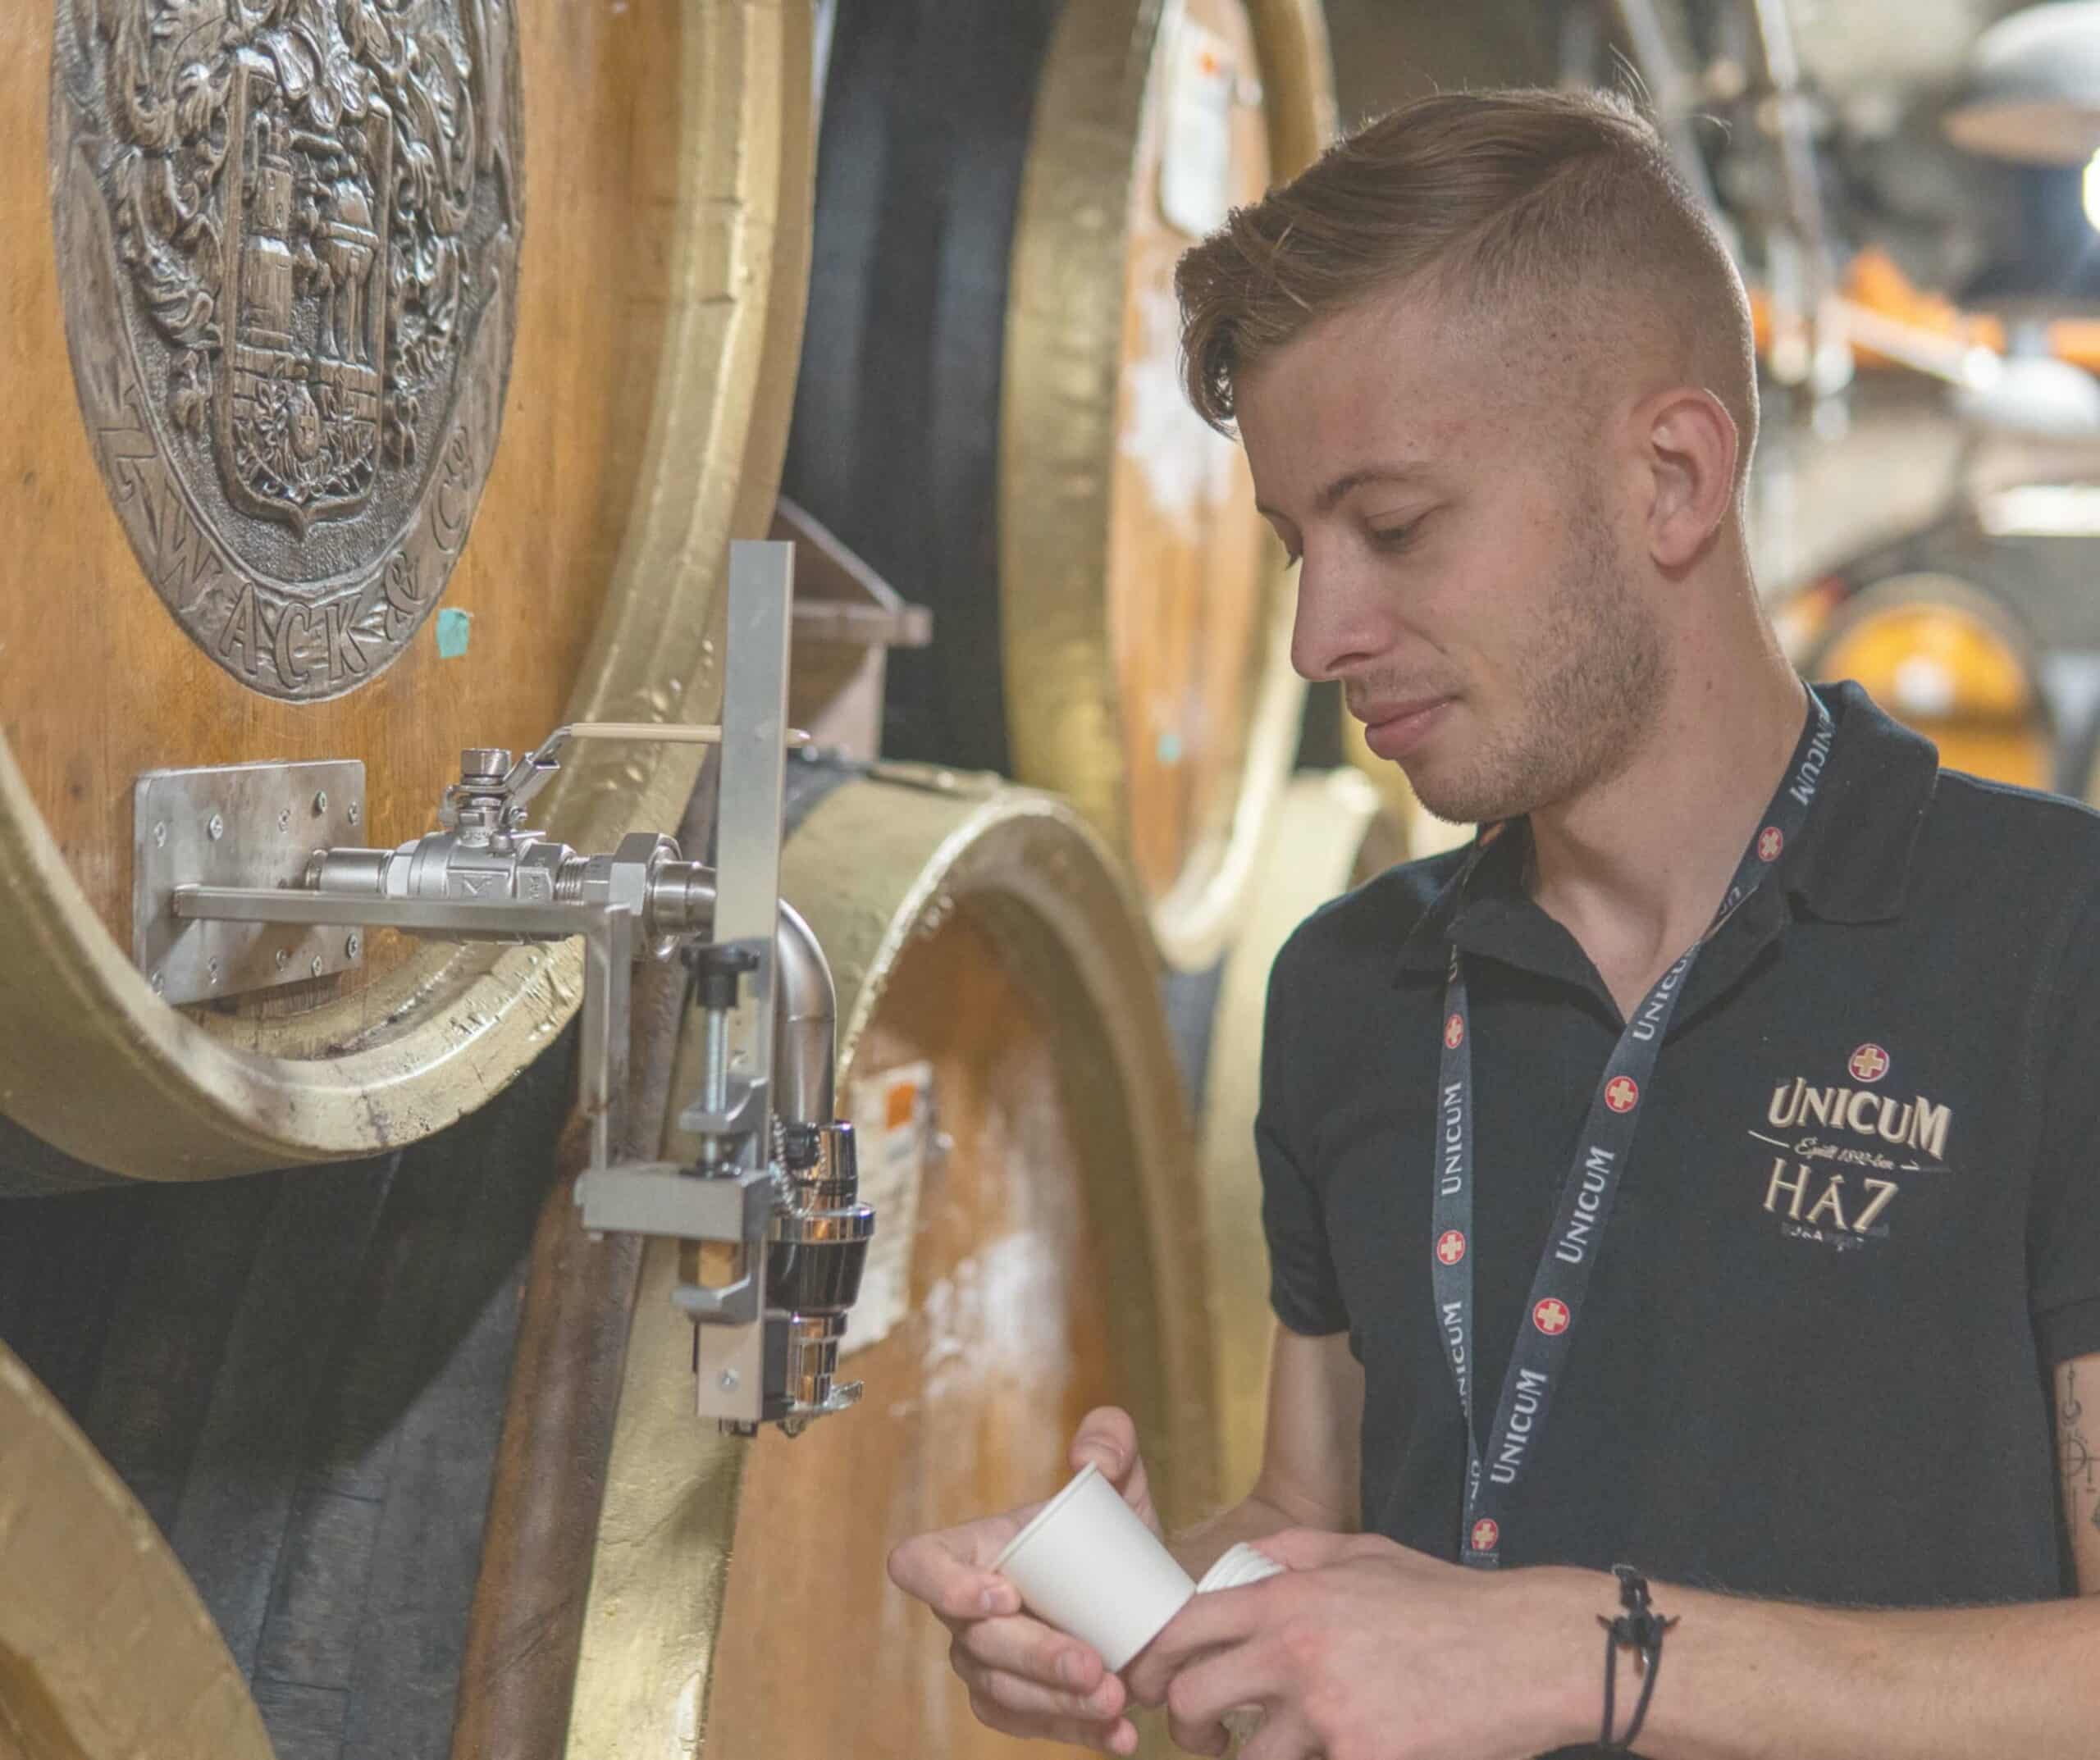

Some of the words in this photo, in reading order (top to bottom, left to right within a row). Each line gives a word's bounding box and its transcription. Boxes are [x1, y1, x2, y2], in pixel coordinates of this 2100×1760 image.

[1632, 943, 1699, 1041] UNICU
[1441, 1082, 1463, 1196] UNICUM
[1768, 1077, 1952, 1160] UNICUM
[1555, 1146, 1615, 1264] UNICUM
[1490, 1368, 1549, 1484] UNICUM
